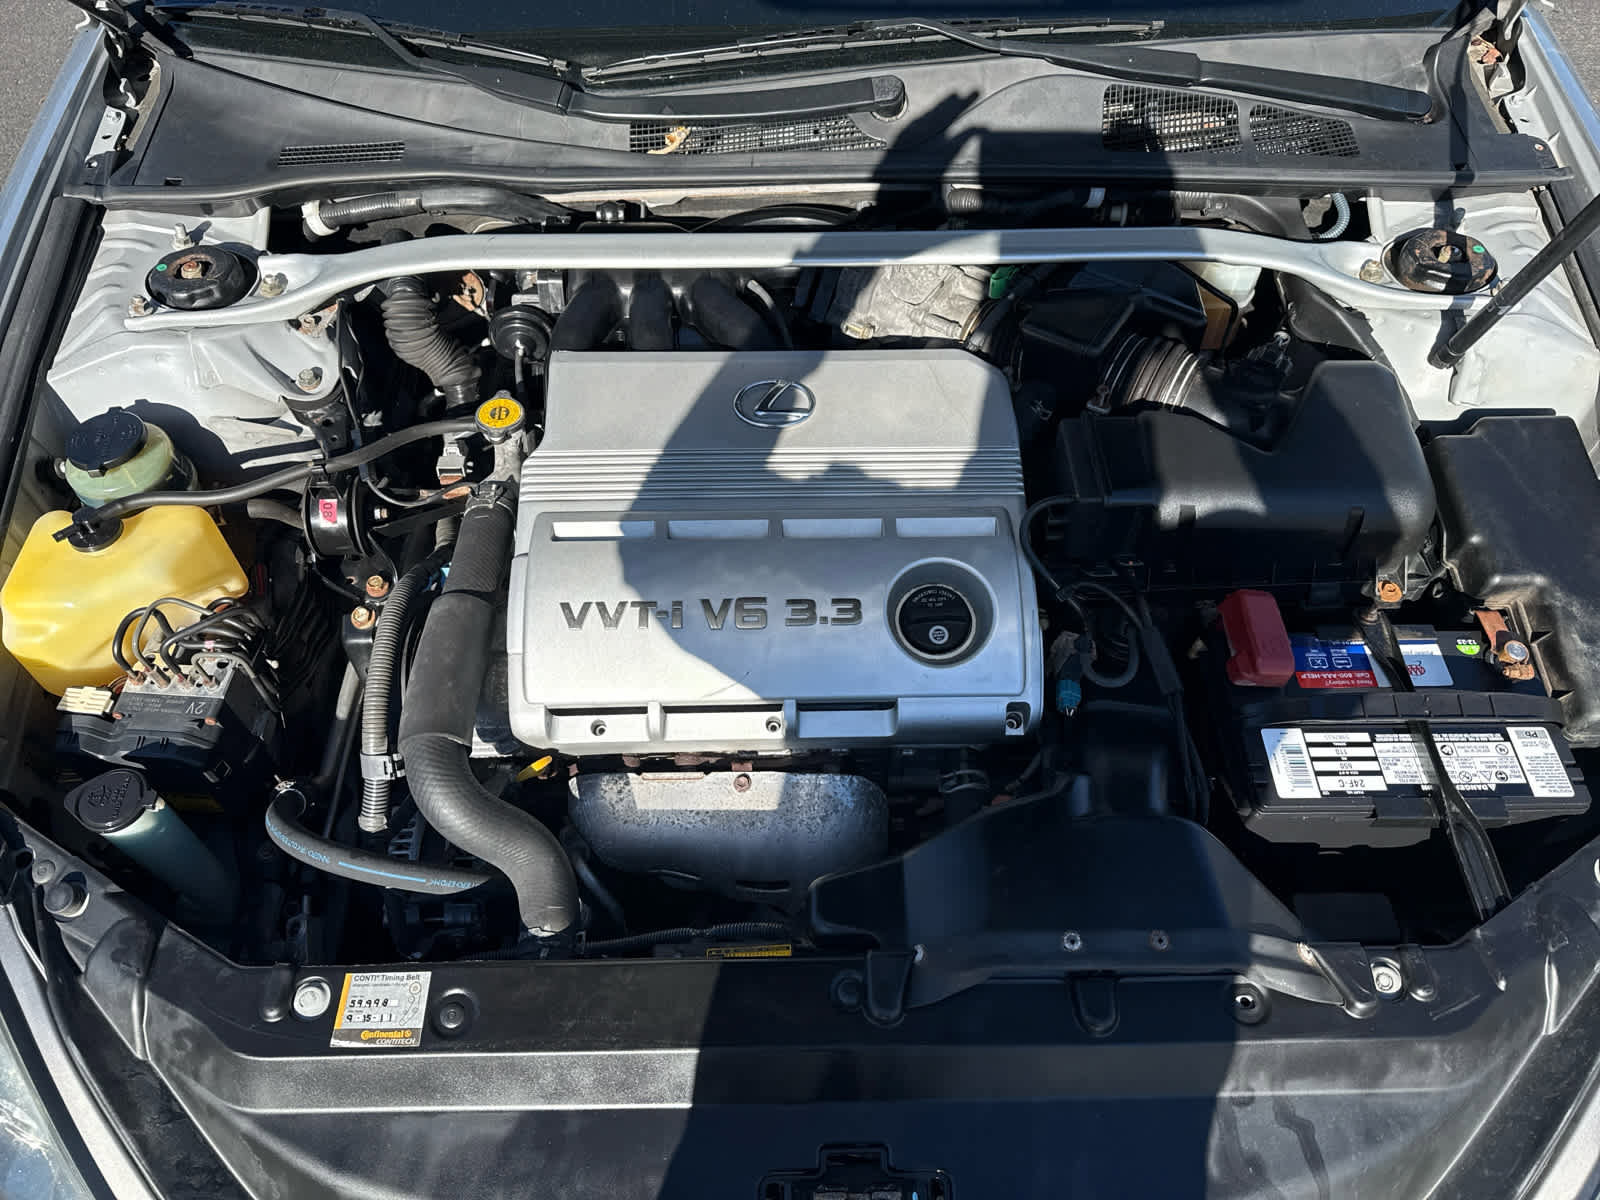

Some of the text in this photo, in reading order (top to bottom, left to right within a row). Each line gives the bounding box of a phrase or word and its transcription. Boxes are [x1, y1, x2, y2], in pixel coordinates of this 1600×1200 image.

[560, 596, 863, 631] VVT-i V6 3.3
[184, 701, 207, 715] 2V
[381, 974, 405, 982] Timing
[360, 1029, 404, 1041] Continental
